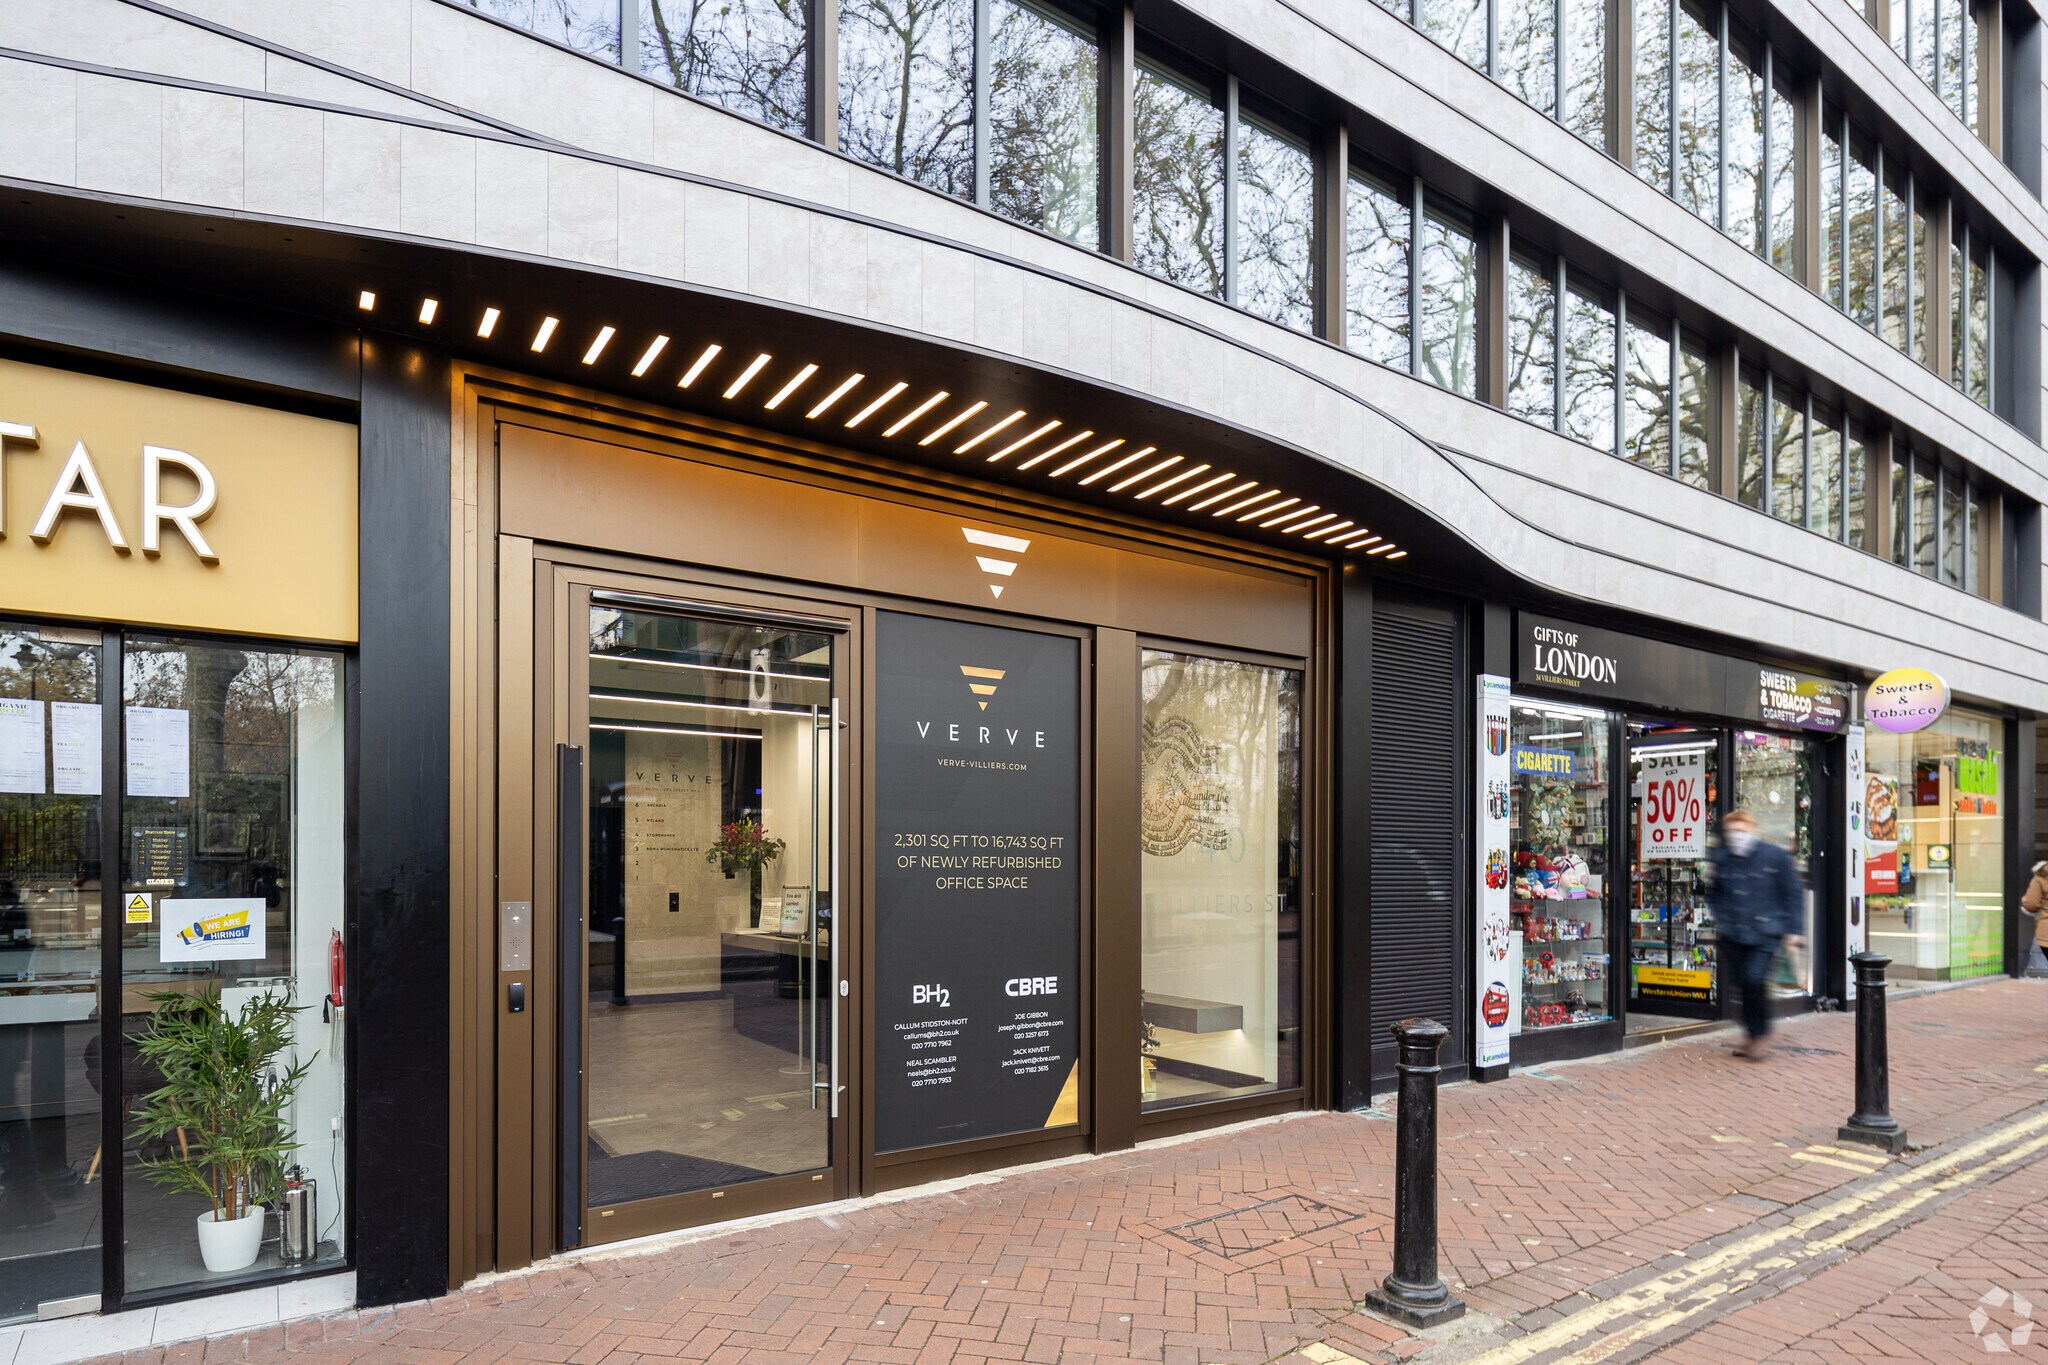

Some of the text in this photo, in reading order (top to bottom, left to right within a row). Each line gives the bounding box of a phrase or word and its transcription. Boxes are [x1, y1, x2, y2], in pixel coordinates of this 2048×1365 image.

[1533, 626, 1579, 647] GIFTS OF
[1534, 644, 1617, 684] LONDON
[1541, 675, 1562, 684] VILLIERS
[1562, 677, 1580, 688] STREET
[1760, 670, 1797, 693] SWEETS
[1875, 682, 1933, 695] Sweets
[1760, 688, 1768, 705] &
[1770, 691, 1812, 714] TOBACCO
[1898, 695, 1908, 705] &
[1763, 707, 1796, 724] CIGARETTE
[1871, 706, 1937, 719] Tobacco
[917, 721, 1045, 748] VERVE
[937, 758, 1027, 771] VERVE-VILLIERS.COM
[1517, 750, 1571, 774] CIGARETTE
[1648, 750, 1698, 769] SALE
[636, 771, 712, 785] VERVE
[1193, 790, 1216, 801] under
[1217, 792, 1230, 804] the
[1647, 778, 1700, 824] 50%
[894, 834, 1064, 850] 2,301 SQ FT TO 16,743 SQ FT
[1652, 828, 1693, 843] OFF
[897, 856, 1062, 869] OF NEWLY REFURBISHED
[935, 877, 1028, 889] OFFICE SPACE
[1265, 894, 1287, 912] ST
[205, 918, 241, 930] WE ARE
[210, 930, 245, 940] HIRING!
[1005, 976, 1058, 997] CBRE
[1642, 987, 1692, 998] WesternUnion
[913, 983, 950, 1007] BH2
[1026, 1011, 1049, 1019] GIBBON
[894, 1018, 968, 1030] CALLUM STIDSTON-NOTT
[1013, 1032, 1025, 1040] 020
[911, 1042, 923, 1050] 020
[906, 1056, 957, 1067] NEAL SCAMBLER
[1014, 1067, 1025, 1075] 020
[911, 1079, 923, 1087] 020
